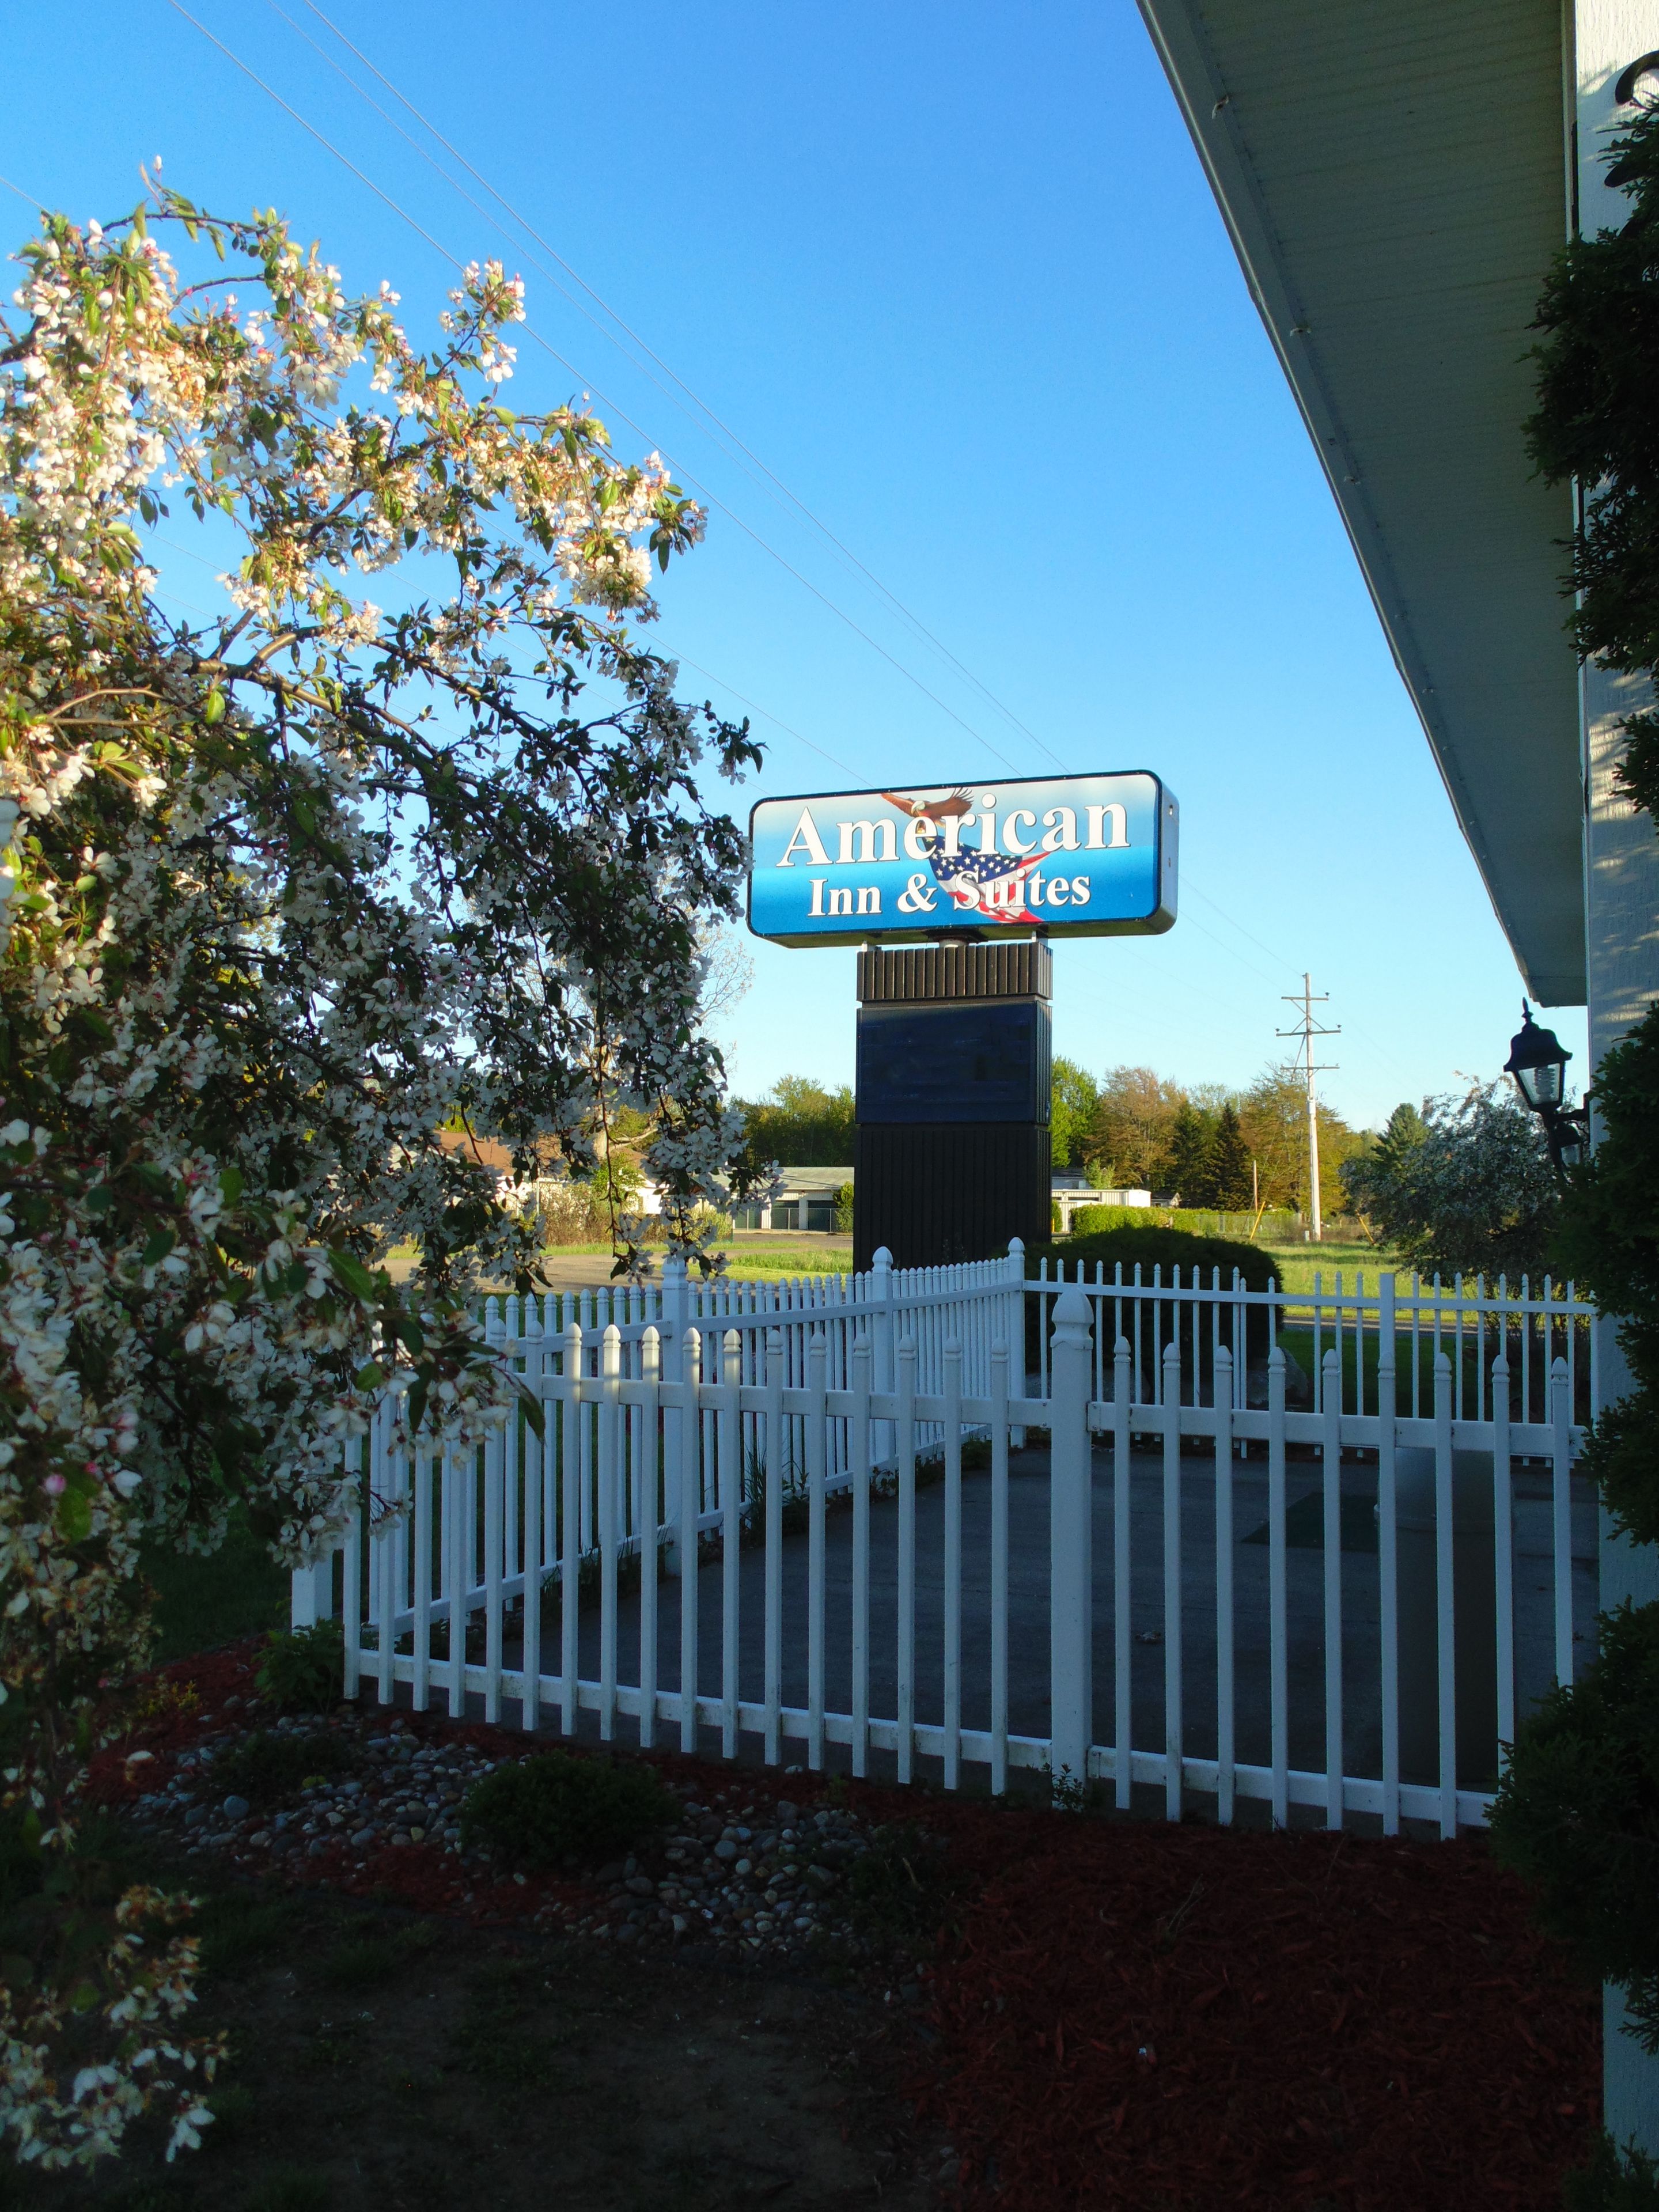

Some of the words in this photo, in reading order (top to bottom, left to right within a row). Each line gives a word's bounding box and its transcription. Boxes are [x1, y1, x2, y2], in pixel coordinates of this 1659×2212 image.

[777, 794, 1130, 866] American
[808, 879, 882, 916] Inn
[898, 874, 937, 912] &
[954, 870, 1090, 910] Suites
